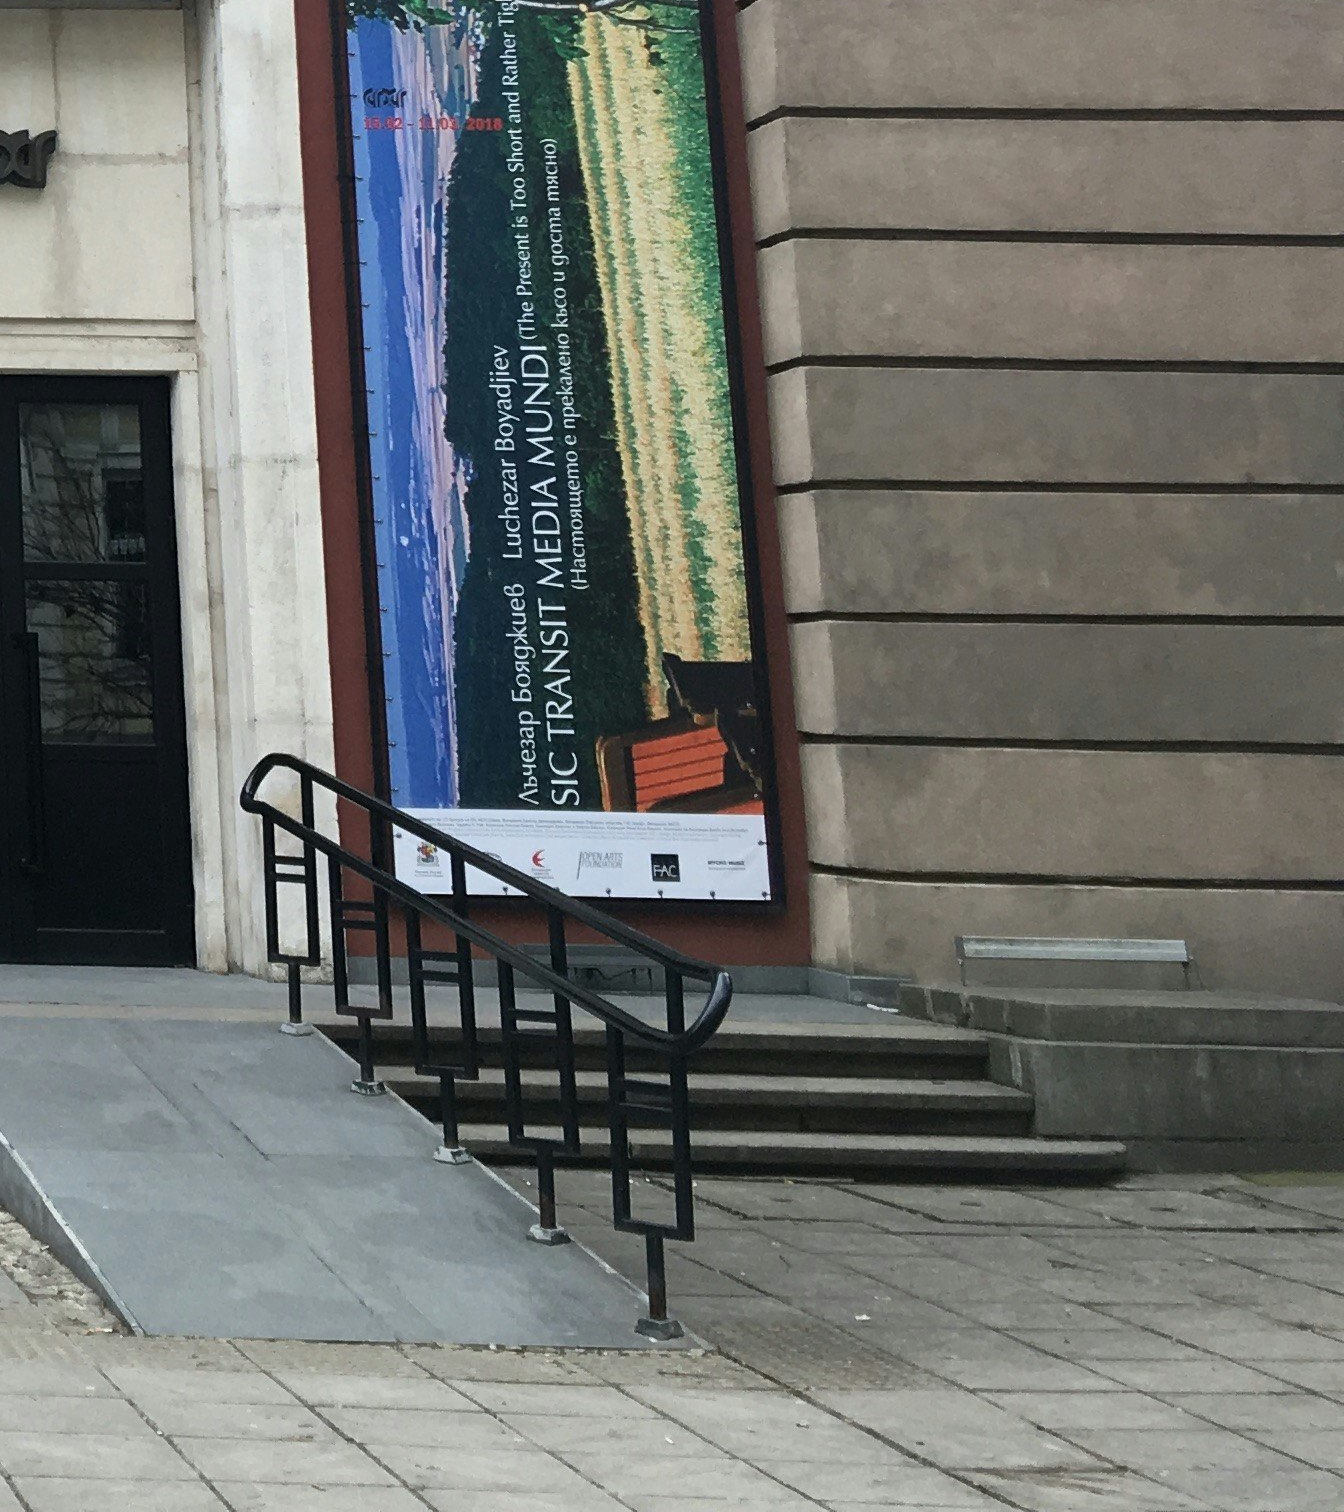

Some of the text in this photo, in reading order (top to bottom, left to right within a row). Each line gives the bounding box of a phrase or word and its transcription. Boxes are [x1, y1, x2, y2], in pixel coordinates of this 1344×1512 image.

[499, 31, 519, 86] Rather
[364, 117, 403, 130] 15.02
[502, 91, 522, 124] and
[506, 128, 525, 173] Short
[510, 177, 527, 210] Too
[511, 215, 529, 228] is
[515, 233, 533, 296] Present
[516, 301, 538, 340] (The
[539, 138, 590, 590] (Настоящето е прекалено късо и доста тясно)
[488, 344, 523, 559] Luchezar Boyadjiev
[519, 345, 581, 806] SIC TRANSIT MEDIA MUNDI
[503, 583, 542, 805] Лъчезар Бояджиев
